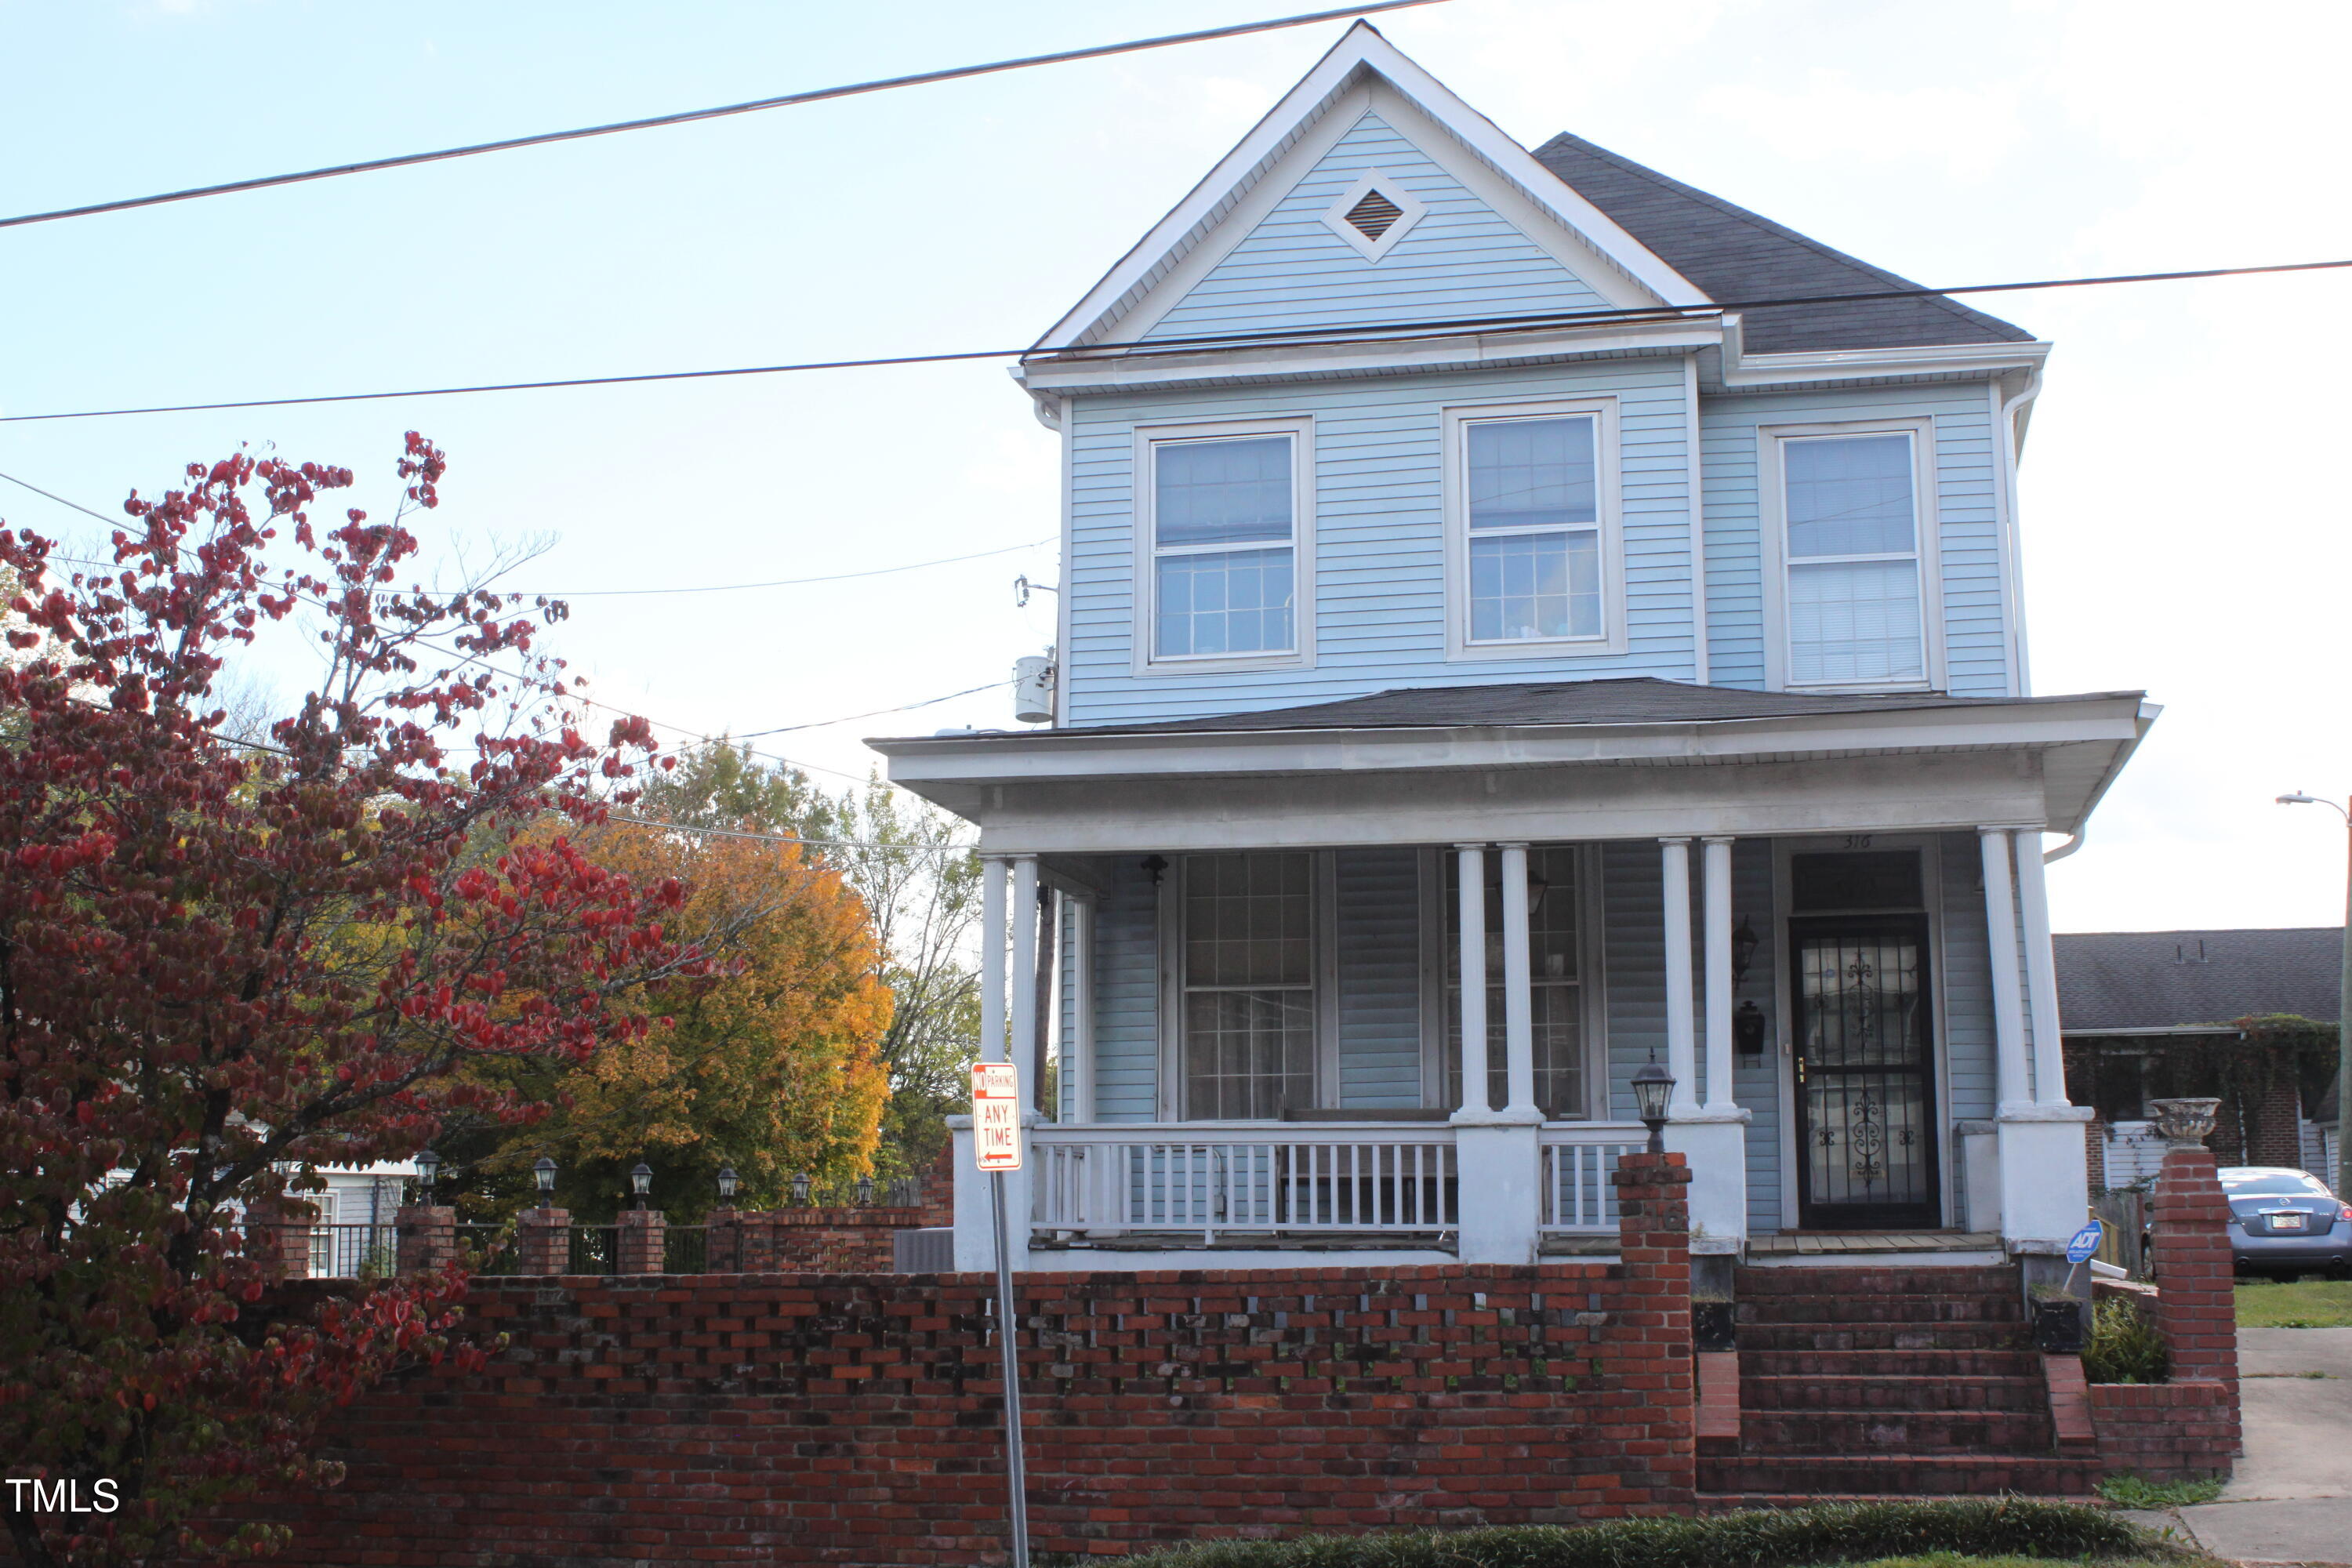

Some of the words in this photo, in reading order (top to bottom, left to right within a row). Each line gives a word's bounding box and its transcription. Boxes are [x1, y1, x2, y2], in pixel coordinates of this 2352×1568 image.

[1843, 833, 1872, 848] 316
[974, 1071, 986, 1091] NO
[987, 1075, 1014, 1088] PARKING
[985, 1104, 1008, 1123] ANY
[984, 1127, 1012, 1146] TIME
[2070, 1232, 2100, 1248] ADT
